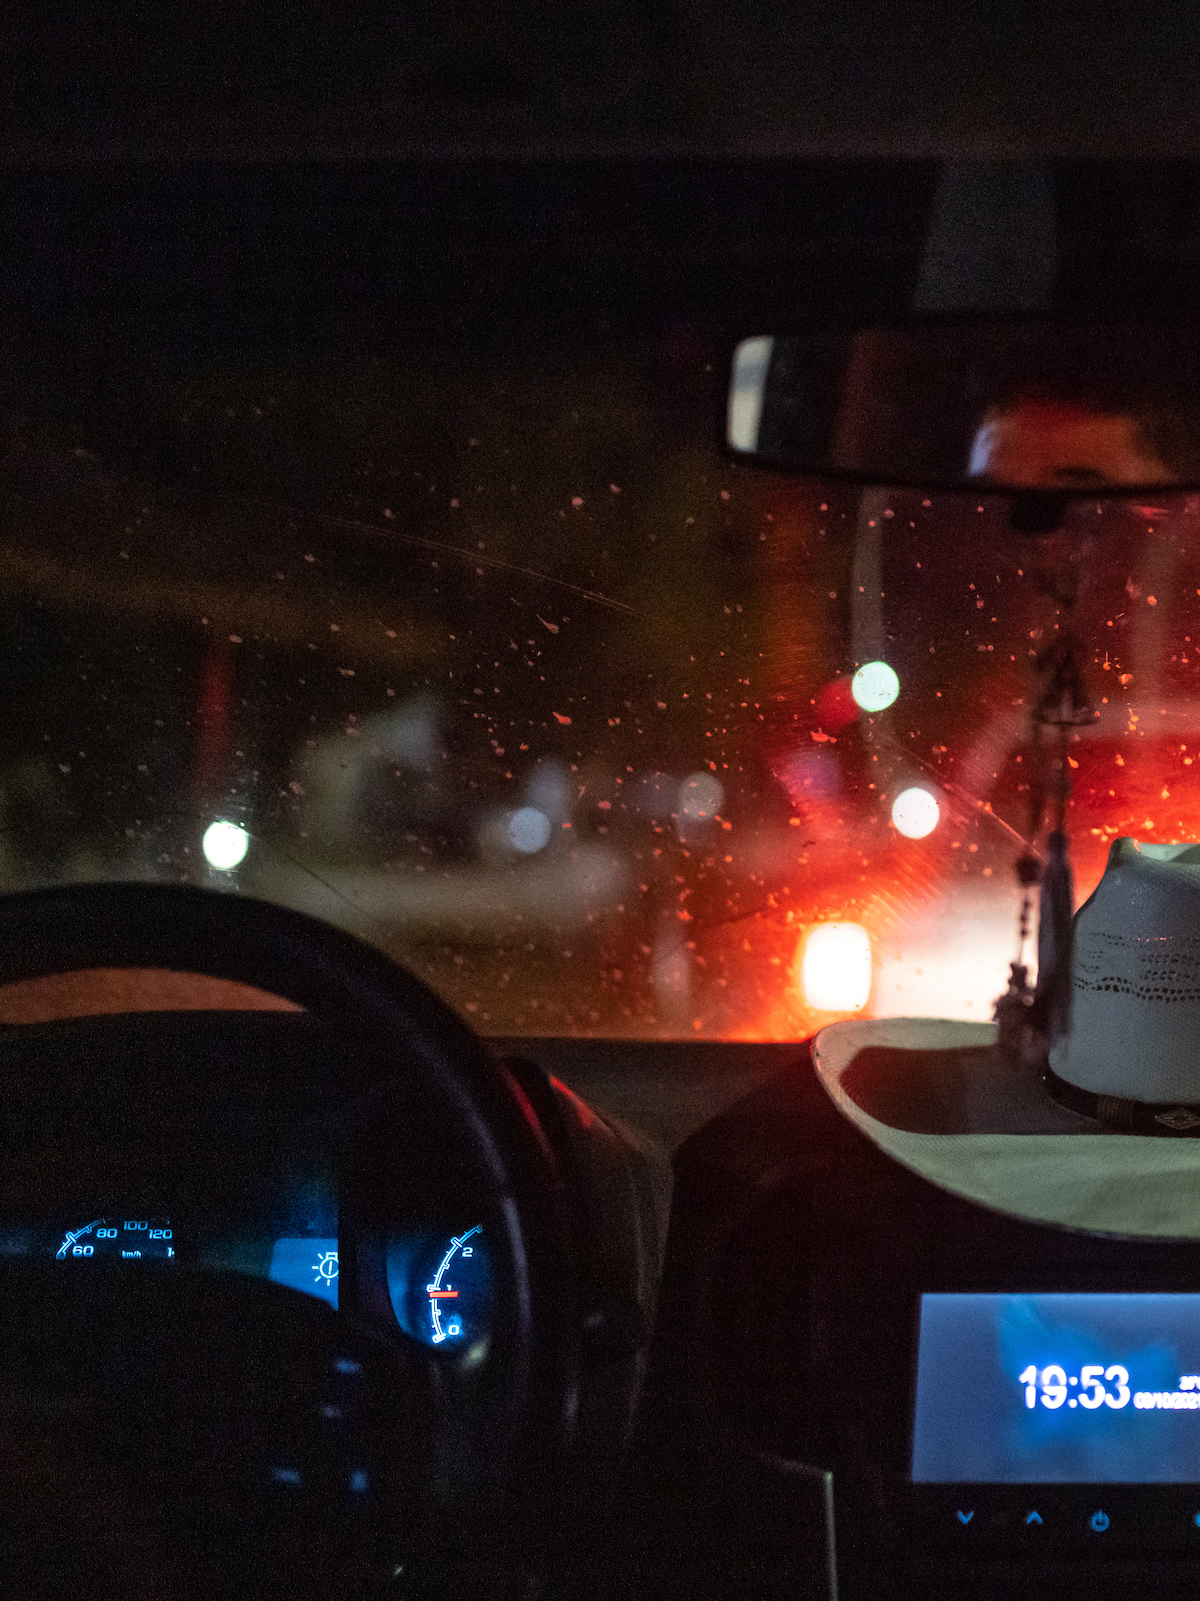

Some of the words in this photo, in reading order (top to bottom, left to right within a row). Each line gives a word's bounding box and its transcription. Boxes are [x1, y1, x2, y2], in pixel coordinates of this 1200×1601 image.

[124, 1220, 148, 1230] 100
[96, 1228, 118, 1238] 80
[149, 1229, 172, 1239] 120
[72, 1245, 94, 1257] 60
[122, 1250, 142, 1258] km/h
[462, 1247, 473, 1257] 2
[448, 1325, 459, 1335] 0
[1019, 1365, 1131, 1409] 19:53
